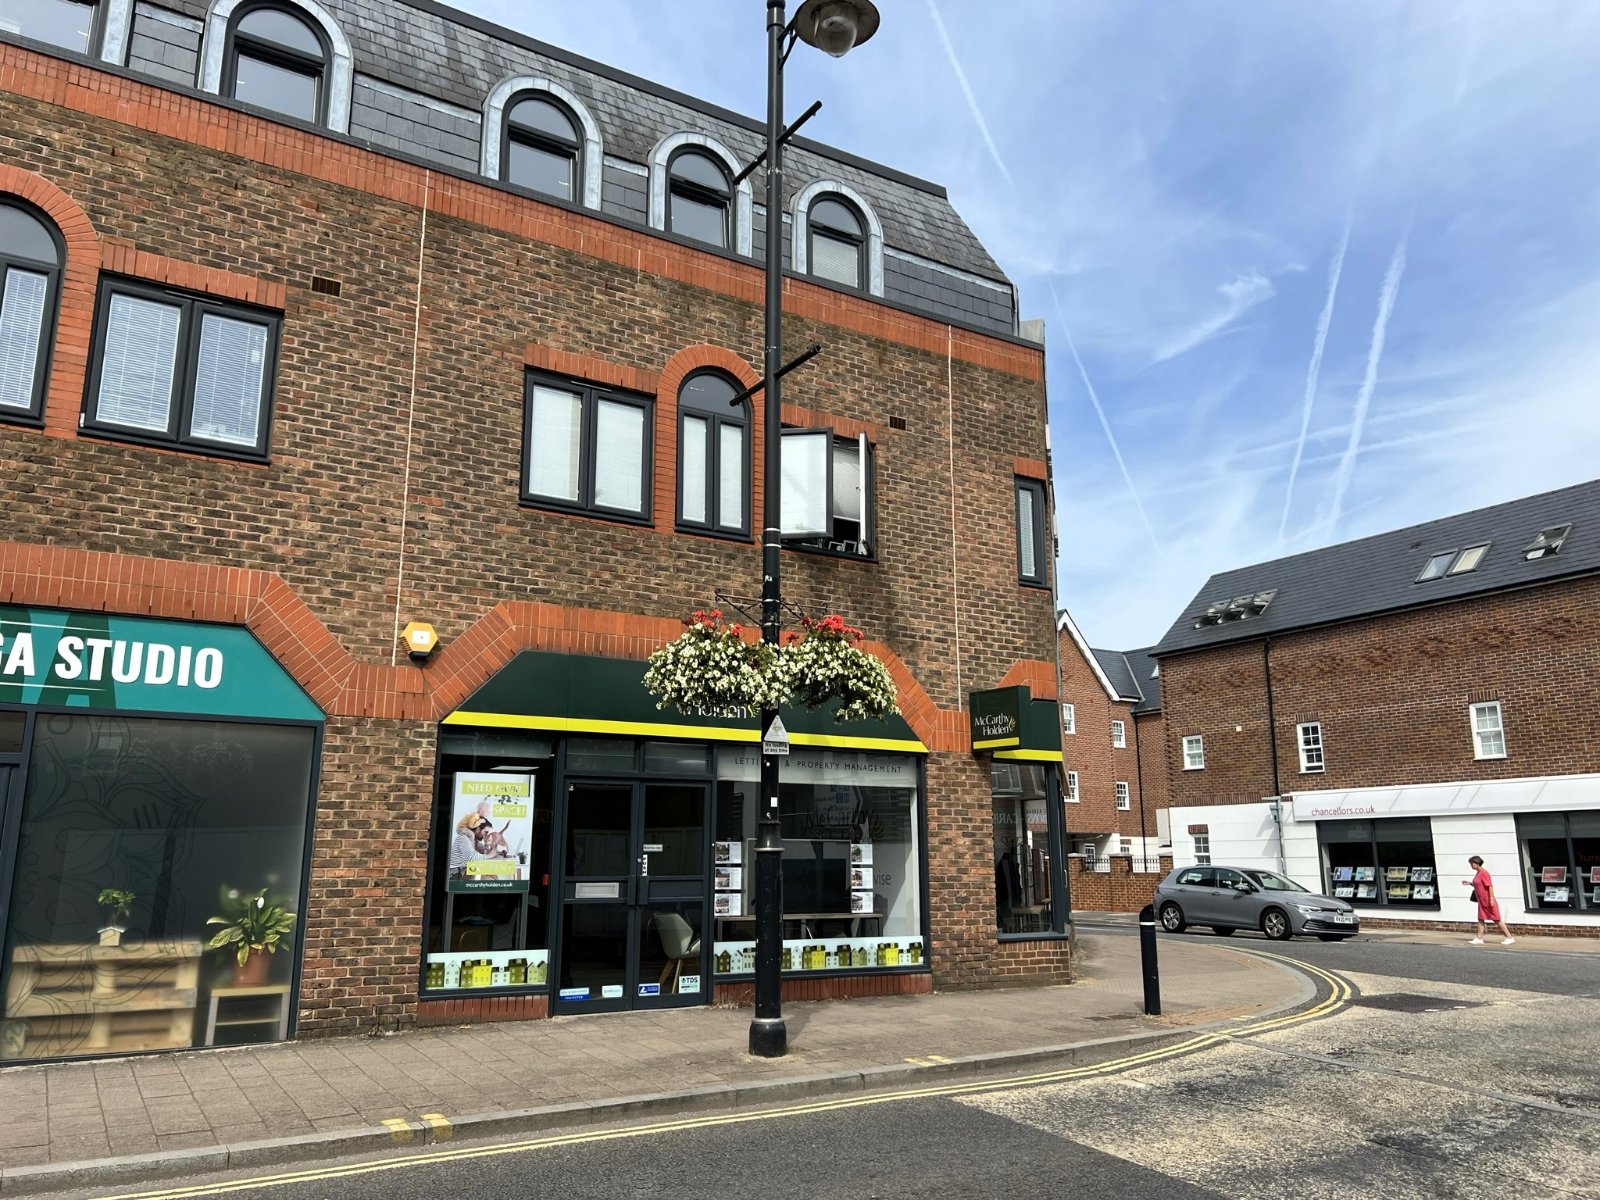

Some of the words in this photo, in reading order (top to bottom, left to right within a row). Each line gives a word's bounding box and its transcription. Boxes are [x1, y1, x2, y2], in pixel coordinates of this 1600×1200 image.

[0, 631, 35, 676] A
[55, 636, 223, 689] STUDIO
[975, 713, 1009, 726] McCarthy
[983, 723, 1009, 736] Holden
[797, 761, 840, 770] PROPERTY
[844, 763, 902, 773] MANAGEMENT
[467, 784, 493, 792] NEED
[1312, 805, 1375, 816] chancellors.co.uk
